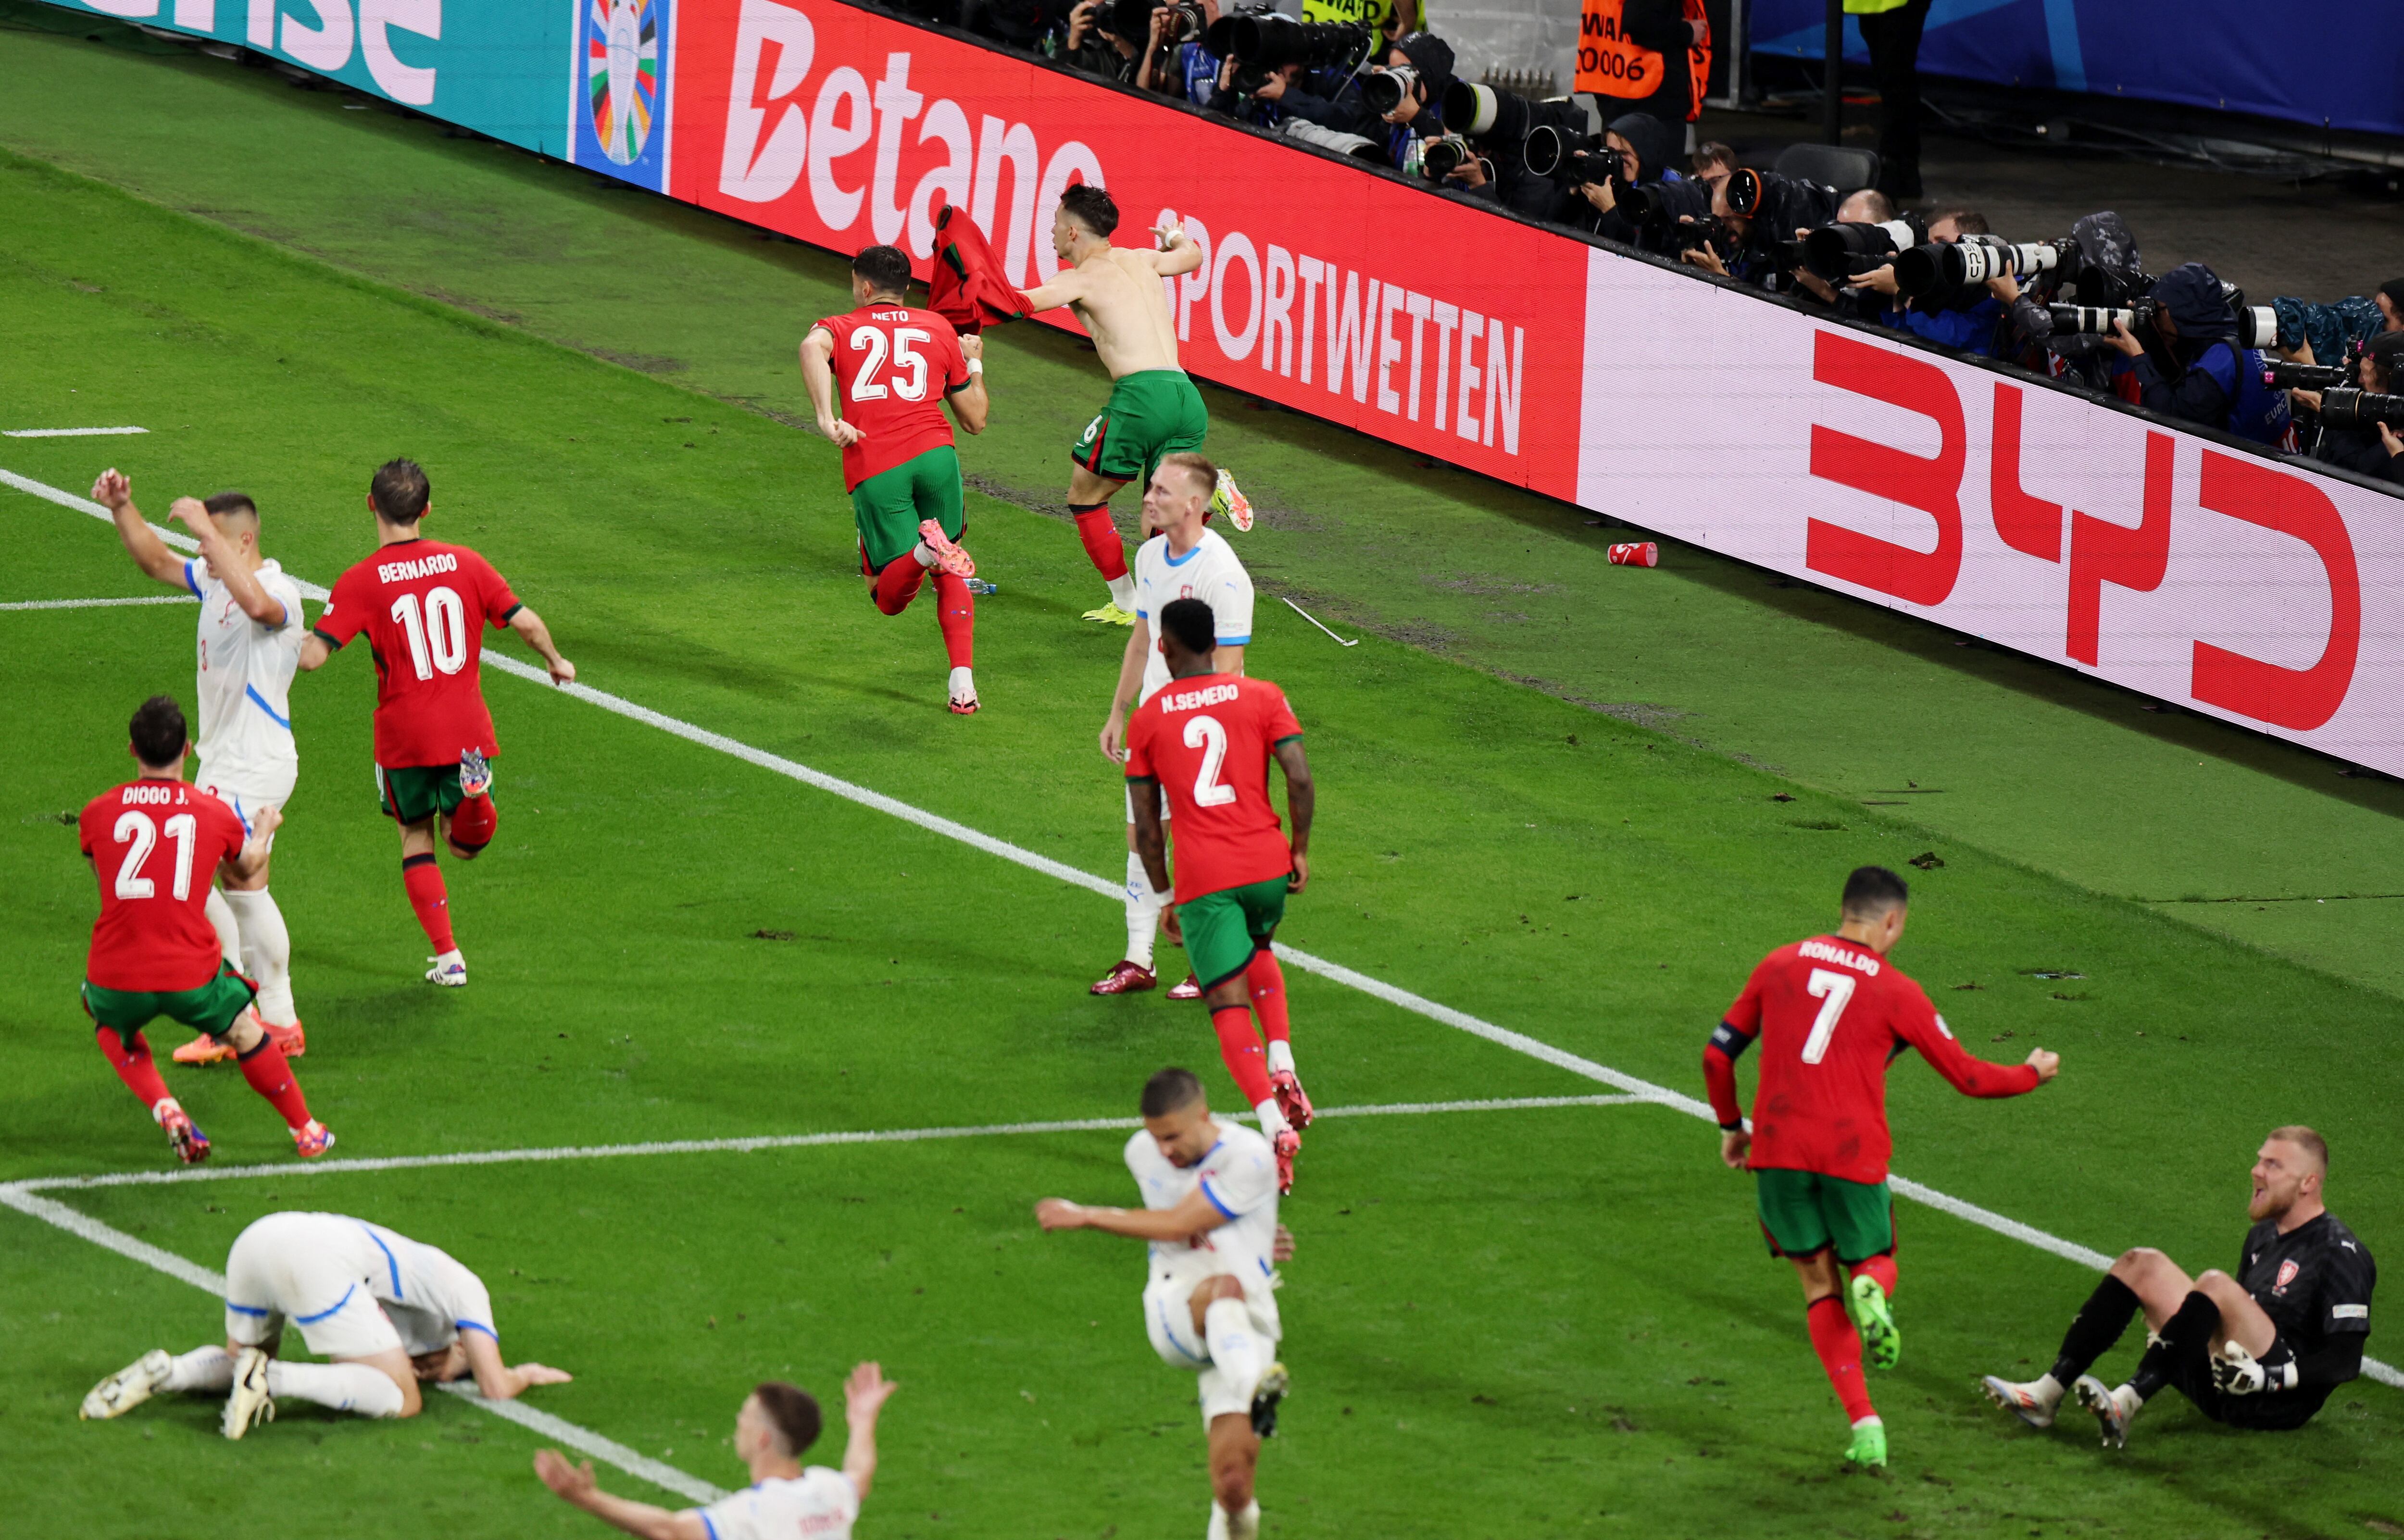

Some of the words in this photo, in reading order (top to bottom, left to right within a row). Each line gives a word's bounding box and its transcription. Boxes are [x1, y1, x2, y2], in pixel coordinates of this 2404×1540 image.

[872, 310, 909, 322] NETO
[850, 325, 931, 402] 25
[1084, 414, 1103, 444] 6
[1806, 329, 2360, 731] BYD
[377, 553, 457, 584] BERNARDO
[390, 586, 466, 681] 10
[1161, 683, 1238, 714] N.SEMEDO
[1183, 715, 1237, 807] 2
[122, 786, 171, 805] DIOGO
[175, 787, 189, 806] J.
[113, 810, 196, 902] 21
[1798, 941, 1880, 977] RONALDO
[1801, 968, 1856, 1065] 7
